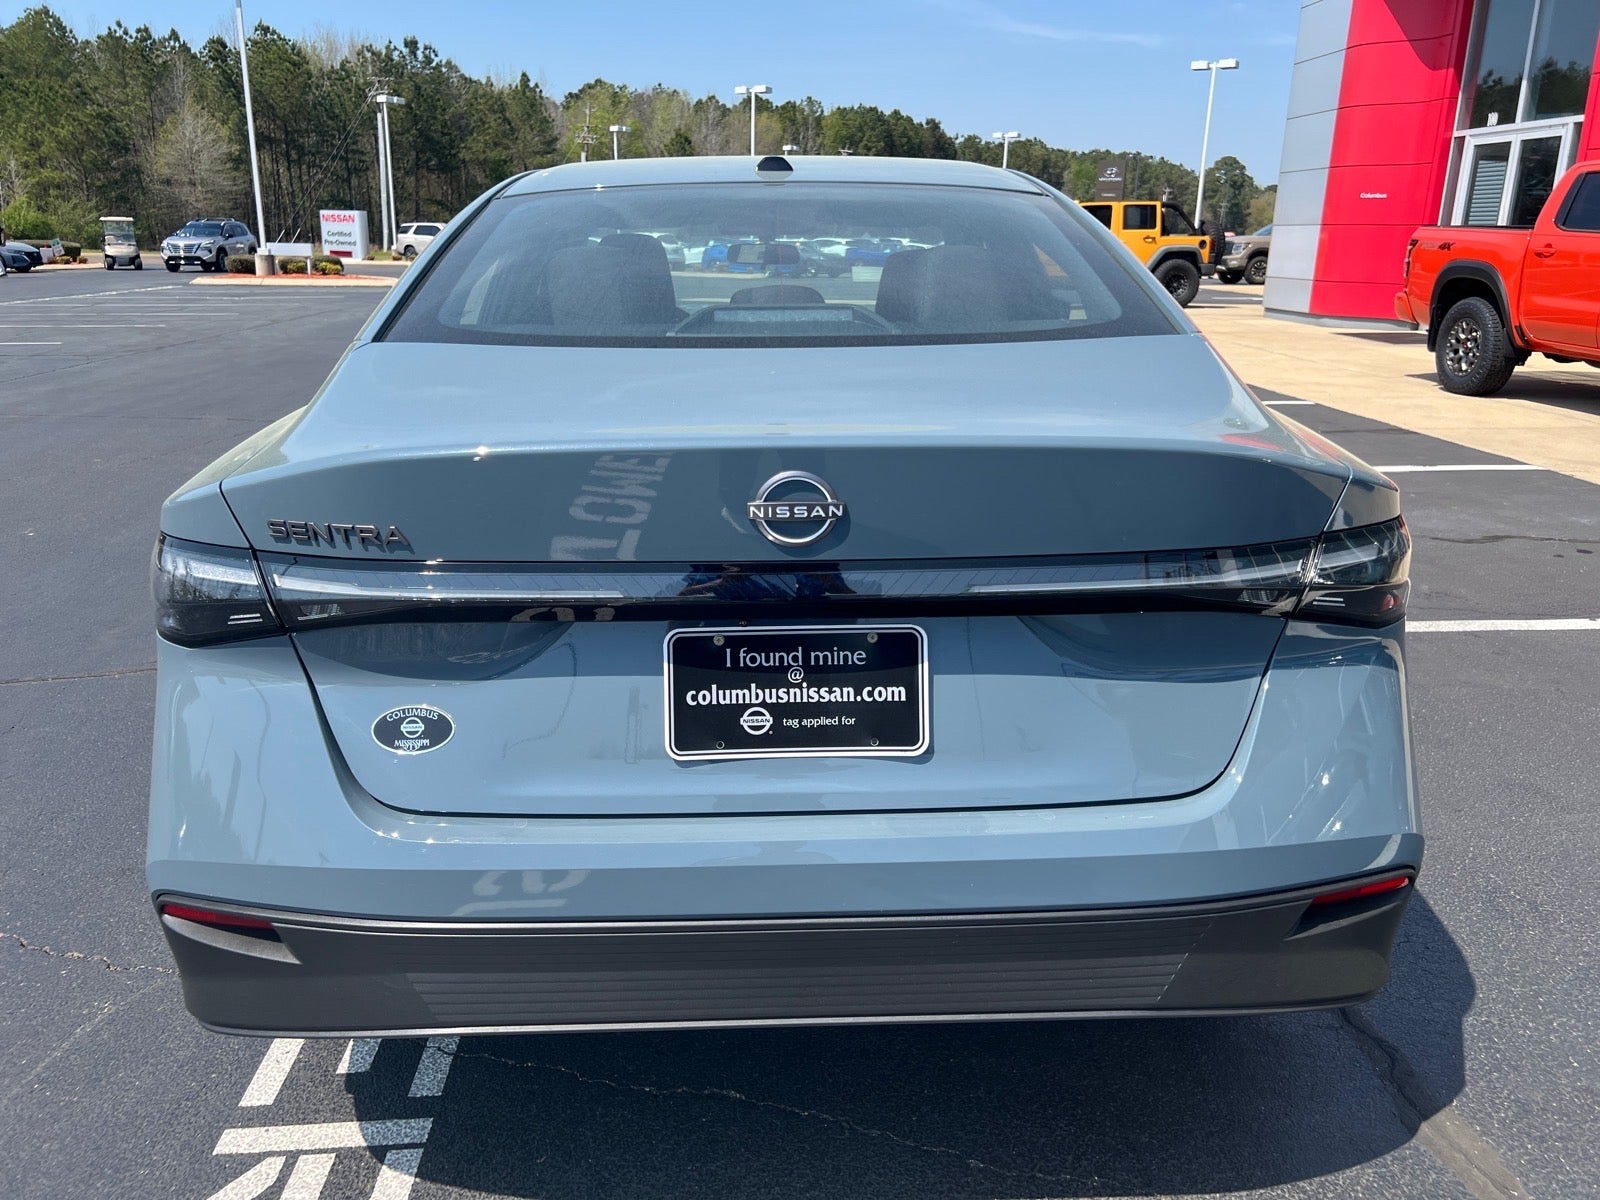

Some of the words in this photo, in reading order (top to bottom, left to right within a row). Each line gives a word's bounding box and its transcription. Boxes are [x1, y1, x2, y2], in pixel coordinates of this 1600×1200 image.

[322, 214, 355, 223] NISSAN
[749, 504, 843, 518] NISSAN
[267, 518, 410, 547] SENTRA
[726, 648, 731, 667] I
[739, 646, 802, 667] found
[810, 646, 867, 666] mine
[788, 666, 804, 683] @
[685, 682, 907, 706] columbusnissan.com
[386, 708, 439, 721] COLUMBUS
[783, 717, 800, 728] tag
[801, 716, 839, 728] applied
[841, 715, 856, 725] for
[394, 739, 430, 751] MISSISSIPPI
